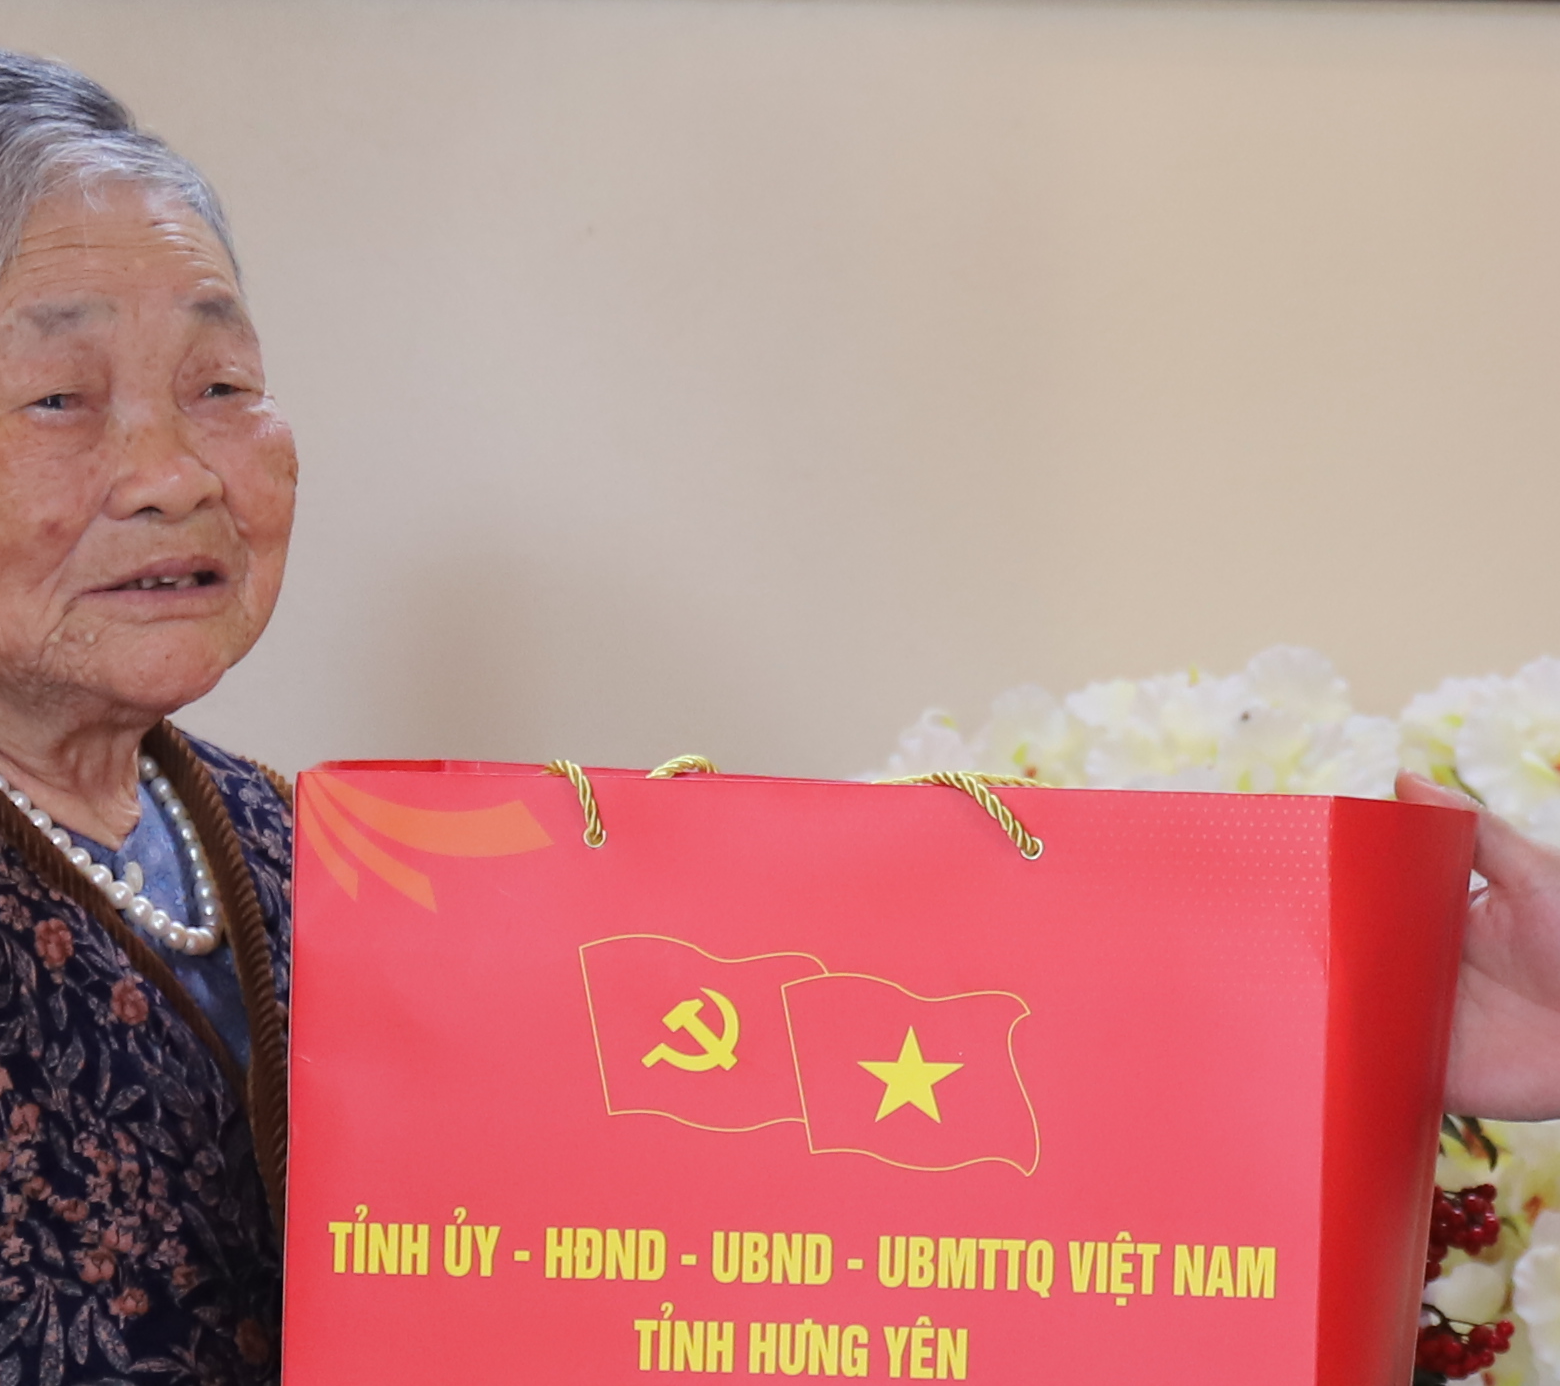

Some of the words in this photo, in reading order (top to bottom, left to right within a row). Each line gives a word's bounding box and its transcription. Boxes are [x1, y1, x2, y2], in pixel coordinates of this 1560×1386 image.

[327, 1204, 431, 1277] TỈNH
[443, 1205, 502, 1278] ỦY
[544, 1226, 668, 1282] HĐND
[711, 1229, 834, 1286] UBND
[877, 1234, 1056, 1300] UBMTTQ
[1067, 1230, 1162, 1308] VIỆT
[1172, 1243, 1277, 1300] NAM
[632, 1300, 736, 1374] TỈNH
[747, 1317, 870, 1379] HƯNG
[882, 1314, 969, 1381] YÊN
